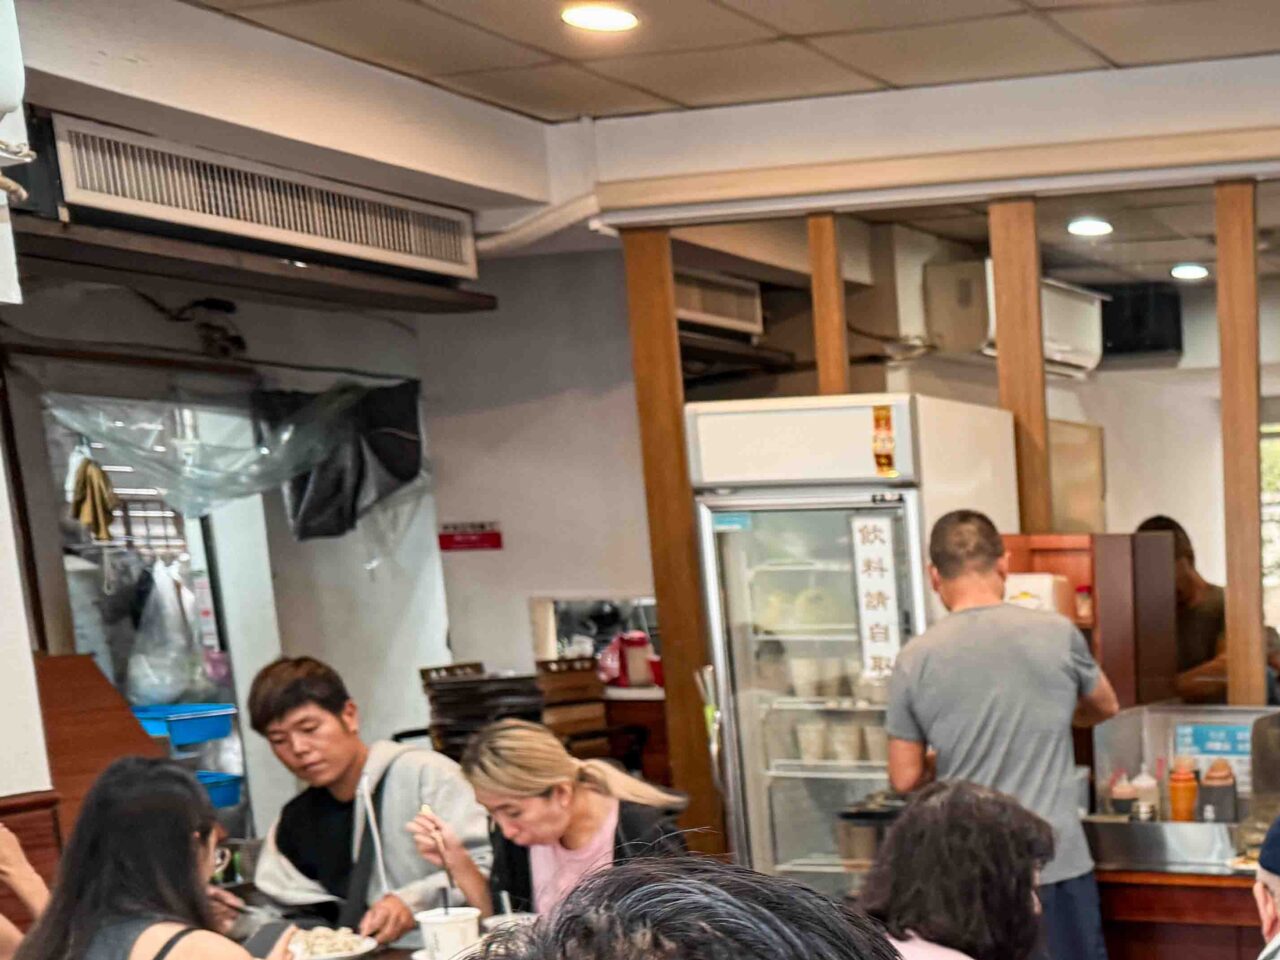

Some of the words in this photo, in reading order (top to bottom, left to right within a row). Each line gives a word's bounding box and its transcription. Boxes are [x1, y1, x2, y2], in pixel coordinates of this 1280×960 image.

[858, 523, 893, 672] 飲料請自取
